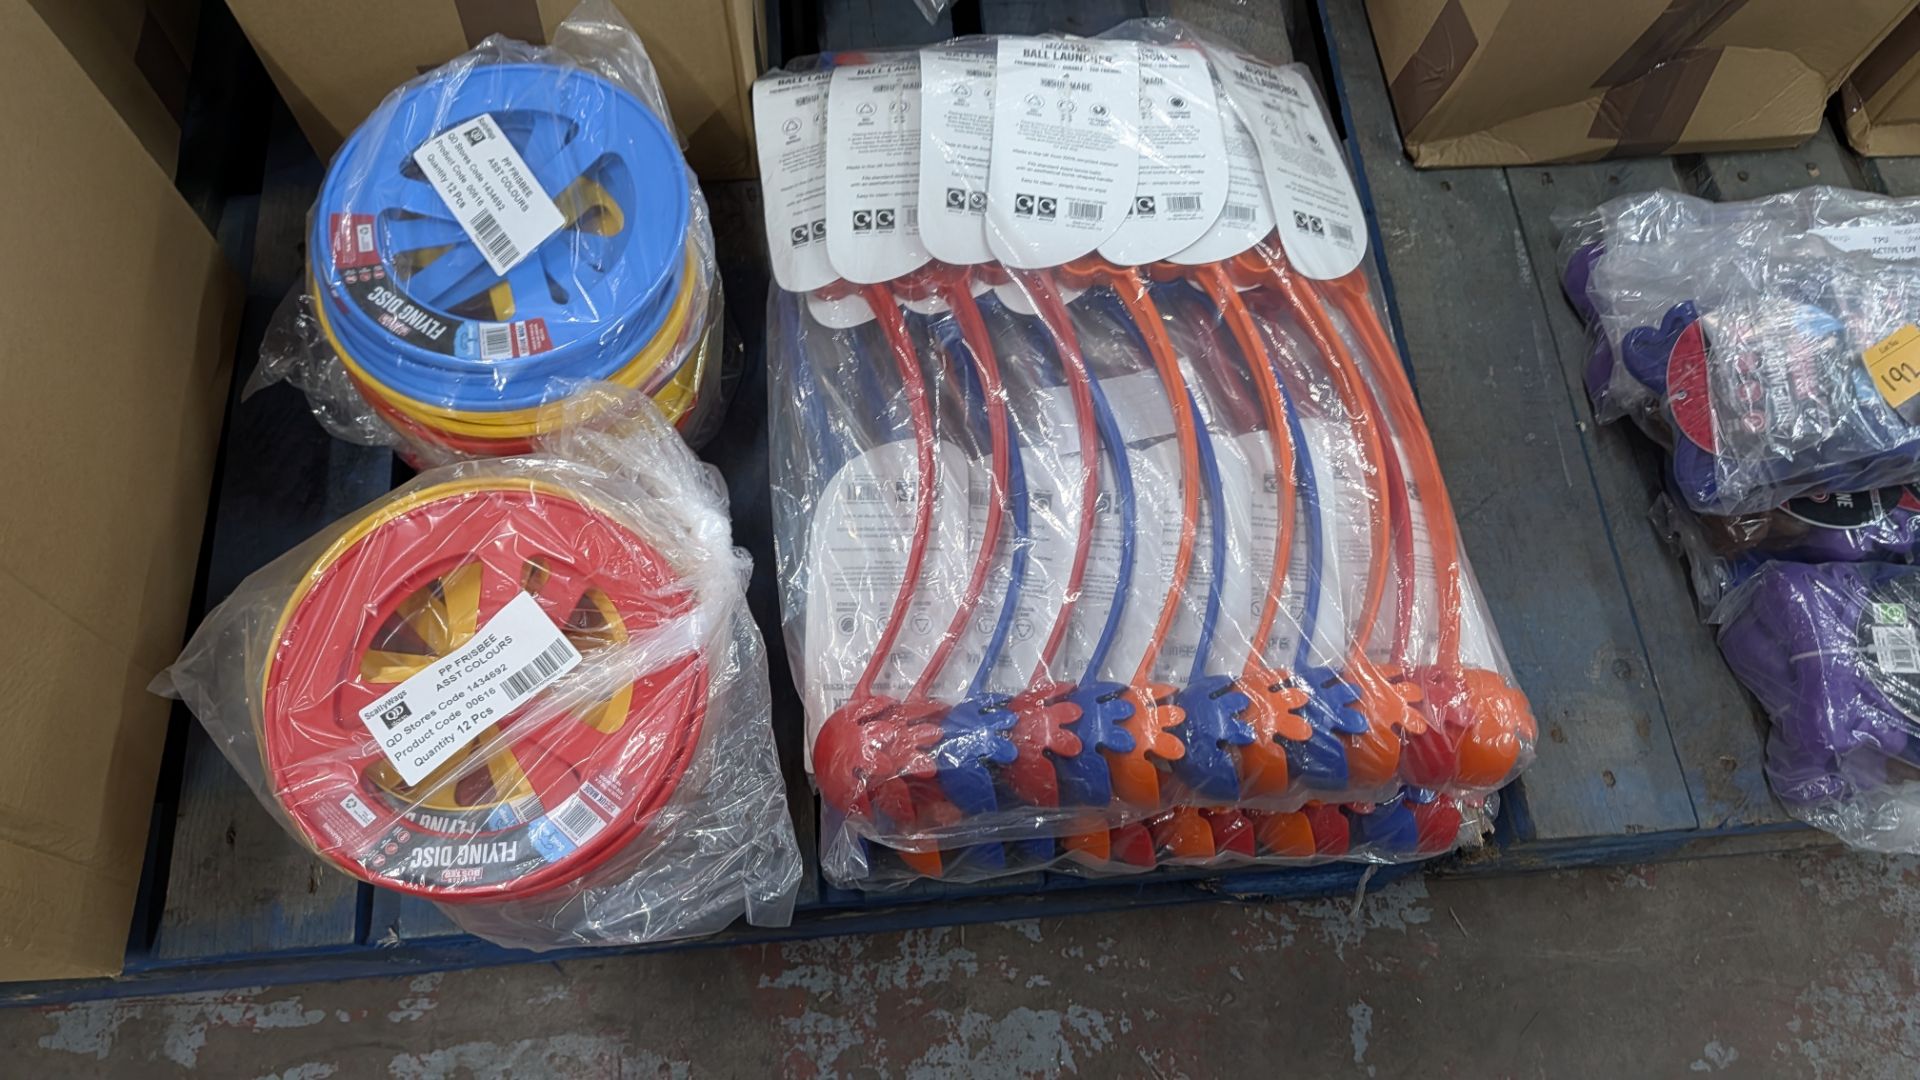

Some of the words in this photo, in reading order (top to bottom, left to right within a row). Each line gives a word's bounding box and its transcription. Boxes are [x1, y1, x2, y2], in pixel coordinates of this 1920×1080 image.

[1024, 49, 1050, 60] BALL
[1054, 51, 1112, 64] LAUNCHER
[1070, 82, 1092, 92] MADE
[436, 140, 456, 166] Product
[452, 164, 468, 184] Code
[448, 132, 459, 146] QD
[455, 140, 472, 166] Stores
[469, 164, 484, 182] Code
[502, 157, 514, 170] PP
[508, 166, 534, 198] FRISBEE
[426, 154, 448, 184] Quantity
[446, 182, 456, 195] 12
[452, 191, 466, 210] Pcs
[488, 158, 504, 176] ASST
[500, 176, 530, 213] COLOURS
[368, 286, 404, 314] DISC
[400, 300, 448, 341] FLYING
[436, 670, 464, 692] ASST
[464, 634, 514, 674] COLOURS
[438, 663, 454, 676] PP
[455, 633, 498, 668] FRISBEE
[364, 688, 408, 721] ScallyWags
[386, 732, 402, 750] QD
[404, 709, 437, 737] Stores
[438, 690, 466, 712] Code
[466, 663, 509, 692] 1434692
[394, 726, 435, 762] Product
[434, 708, 462, 732] Code
[465, 686, 497, 711] 00616
[414, 733, 456, 768] Quantity
[456, 720, 473, 736] 12
[472, 706, 495, 726] Pcs
[410, 846, 453, 868] DISC
[456, 841, 518, 866] FLYING
